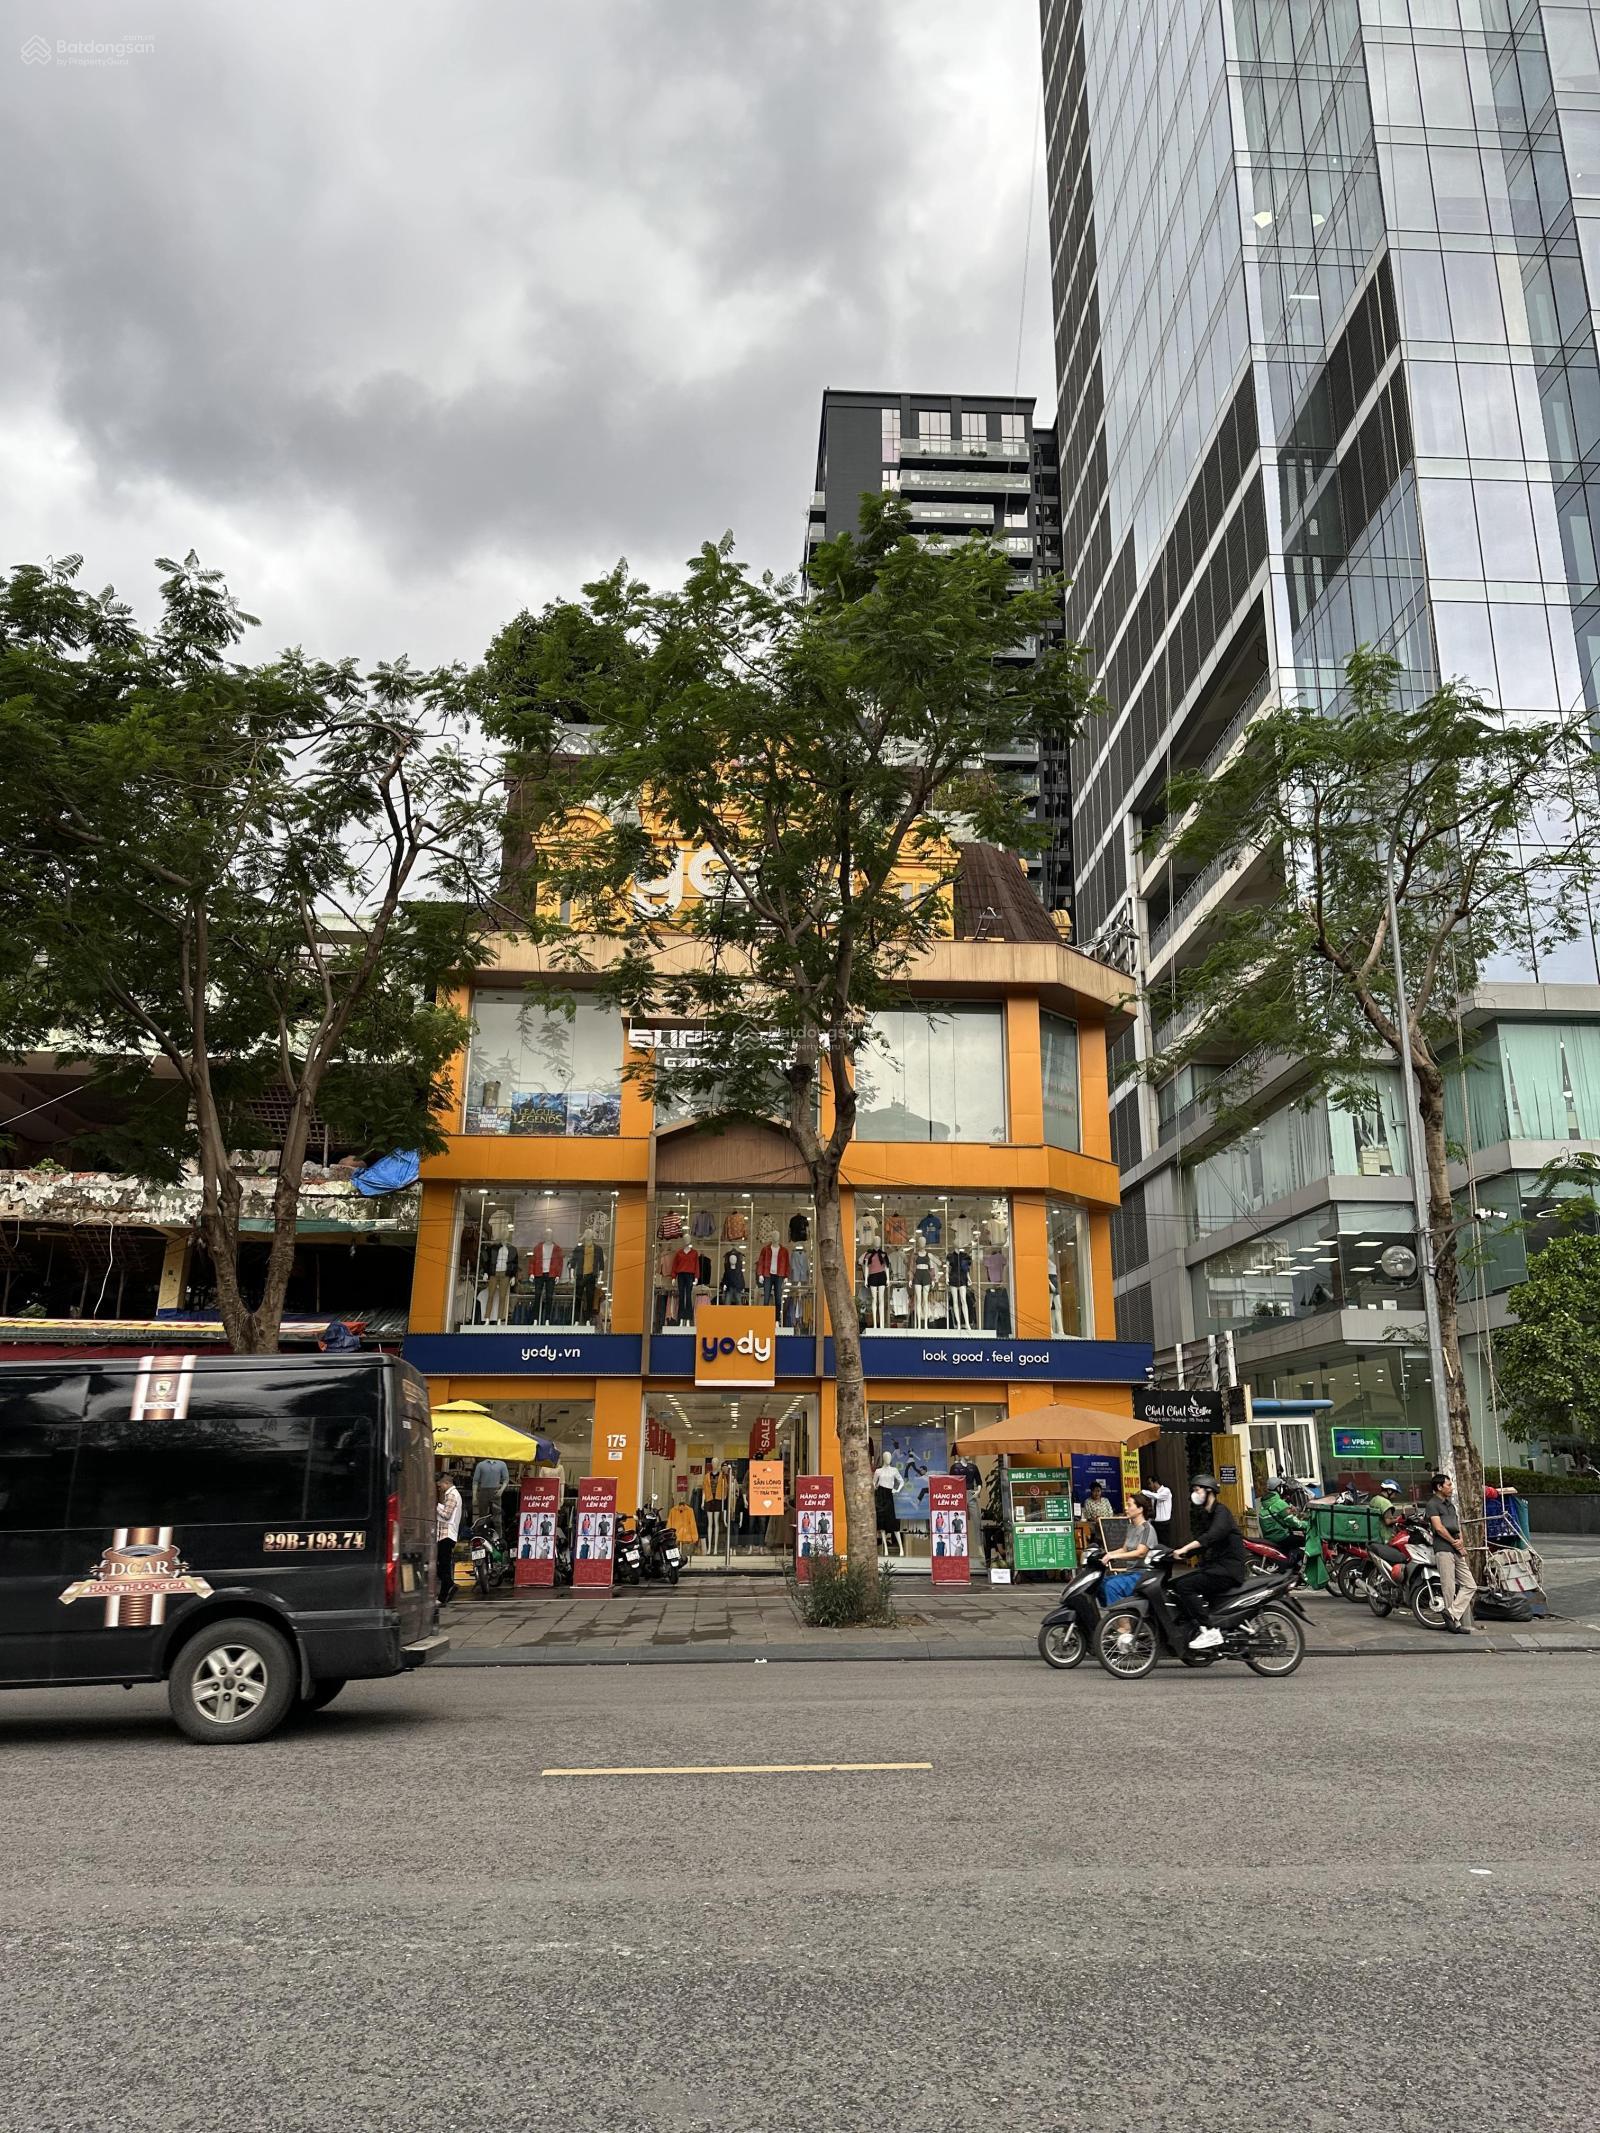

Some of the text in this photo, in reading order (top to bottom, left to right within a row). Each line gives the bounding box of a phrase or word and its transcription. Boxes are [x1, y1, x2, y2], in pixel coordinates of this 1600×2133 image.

[512, 1113, 565, 1126] LEGENDS
[519, 1108, 555, 1117] LEAGUE
[521, 1345, 581, 1361] yody.vn
[701, 1329, 772, 1362] yody
[922, 1349, 948, 1361] look
[992, 1350, 1014, 1363] feel
[1018, 1352, 1049, 1366] good
[606, 1434, 627, 1448] 175
[761, 1418, 771, 1448] SALE
[800, 1492, 817, 1500] HÀNG
[933, 1492, 950, 1500] HÀNG
[264, 1532, 364, 1550] 29B-193.74
[110, 1560, 170, 1577] DCAR
